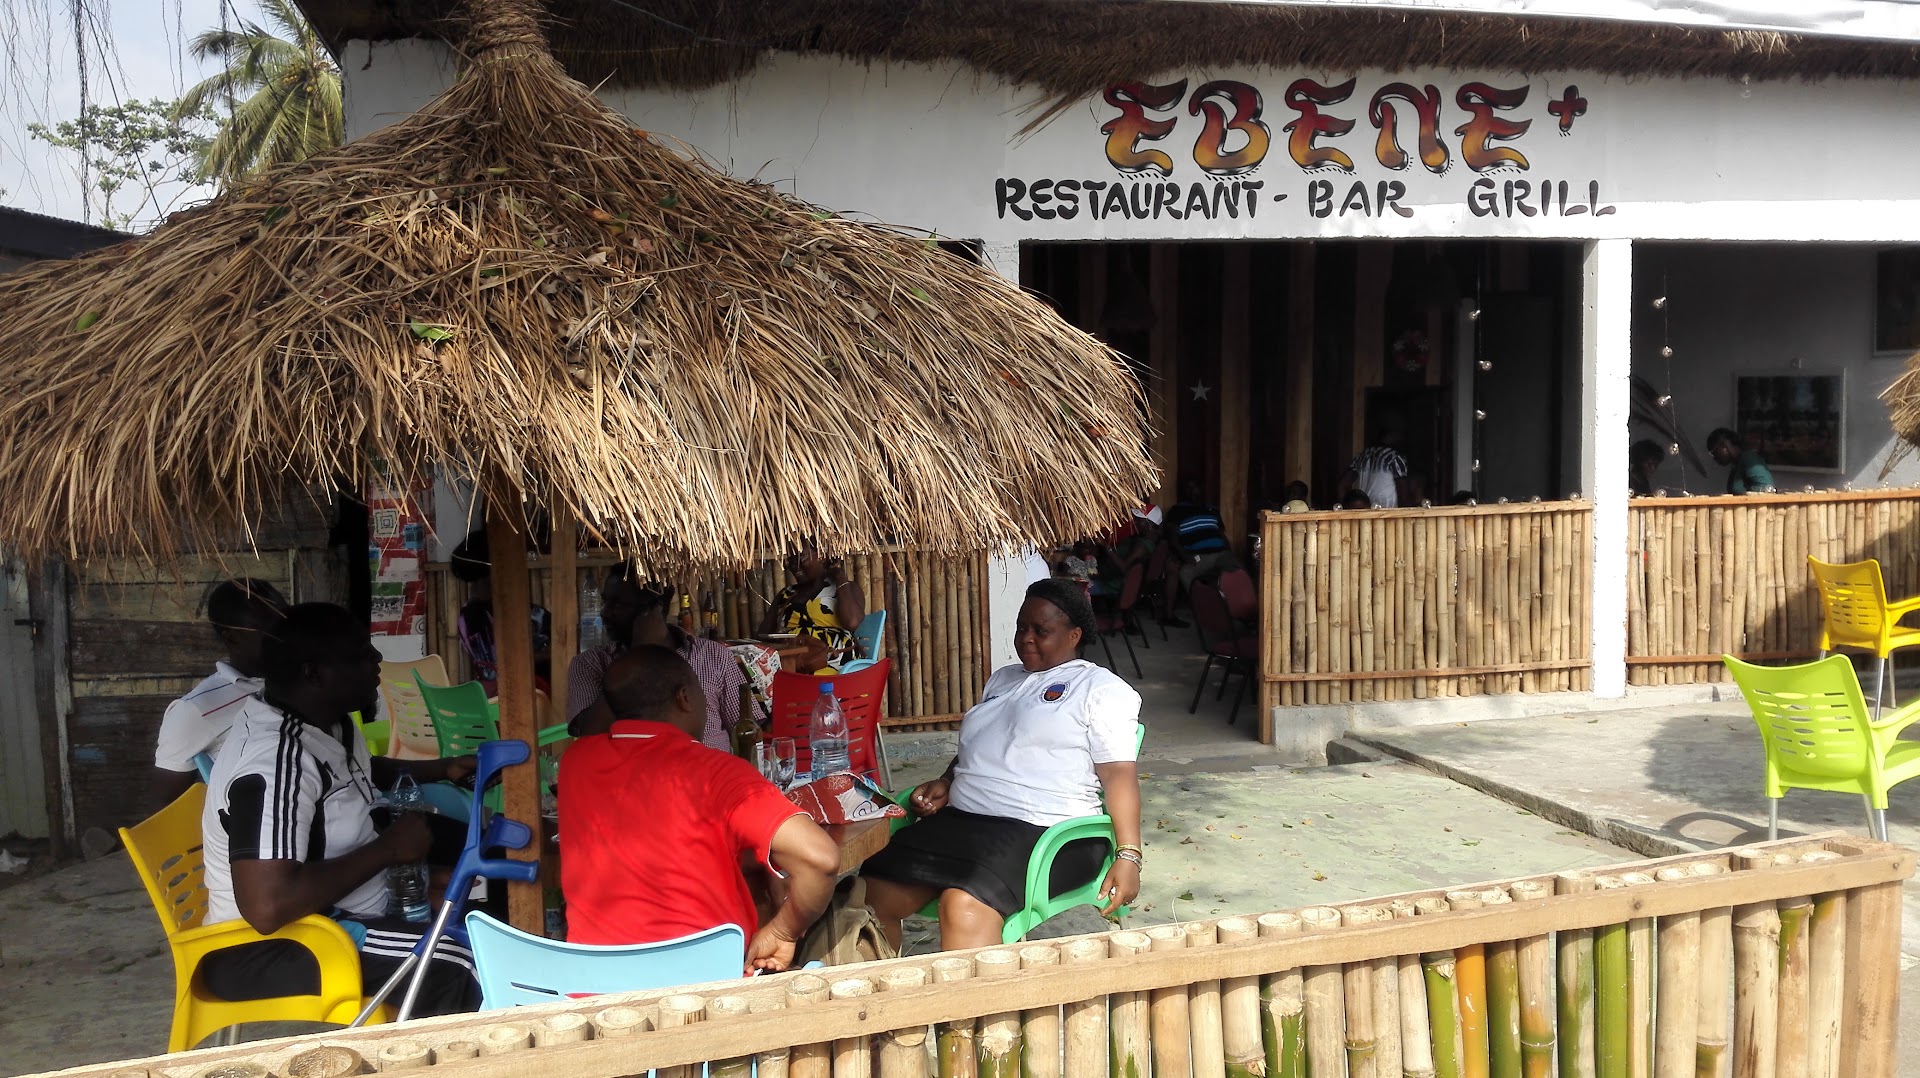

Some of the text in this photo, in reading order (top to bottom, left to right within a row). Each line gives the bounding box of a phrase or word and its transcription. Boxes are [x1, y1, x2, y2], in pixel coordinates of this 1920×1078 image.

[995, 178, 1264, 220] RESTAURANT
[1308, 180, 1414, 218] BAR
[1467, 178, 1616, 218] GRILL
